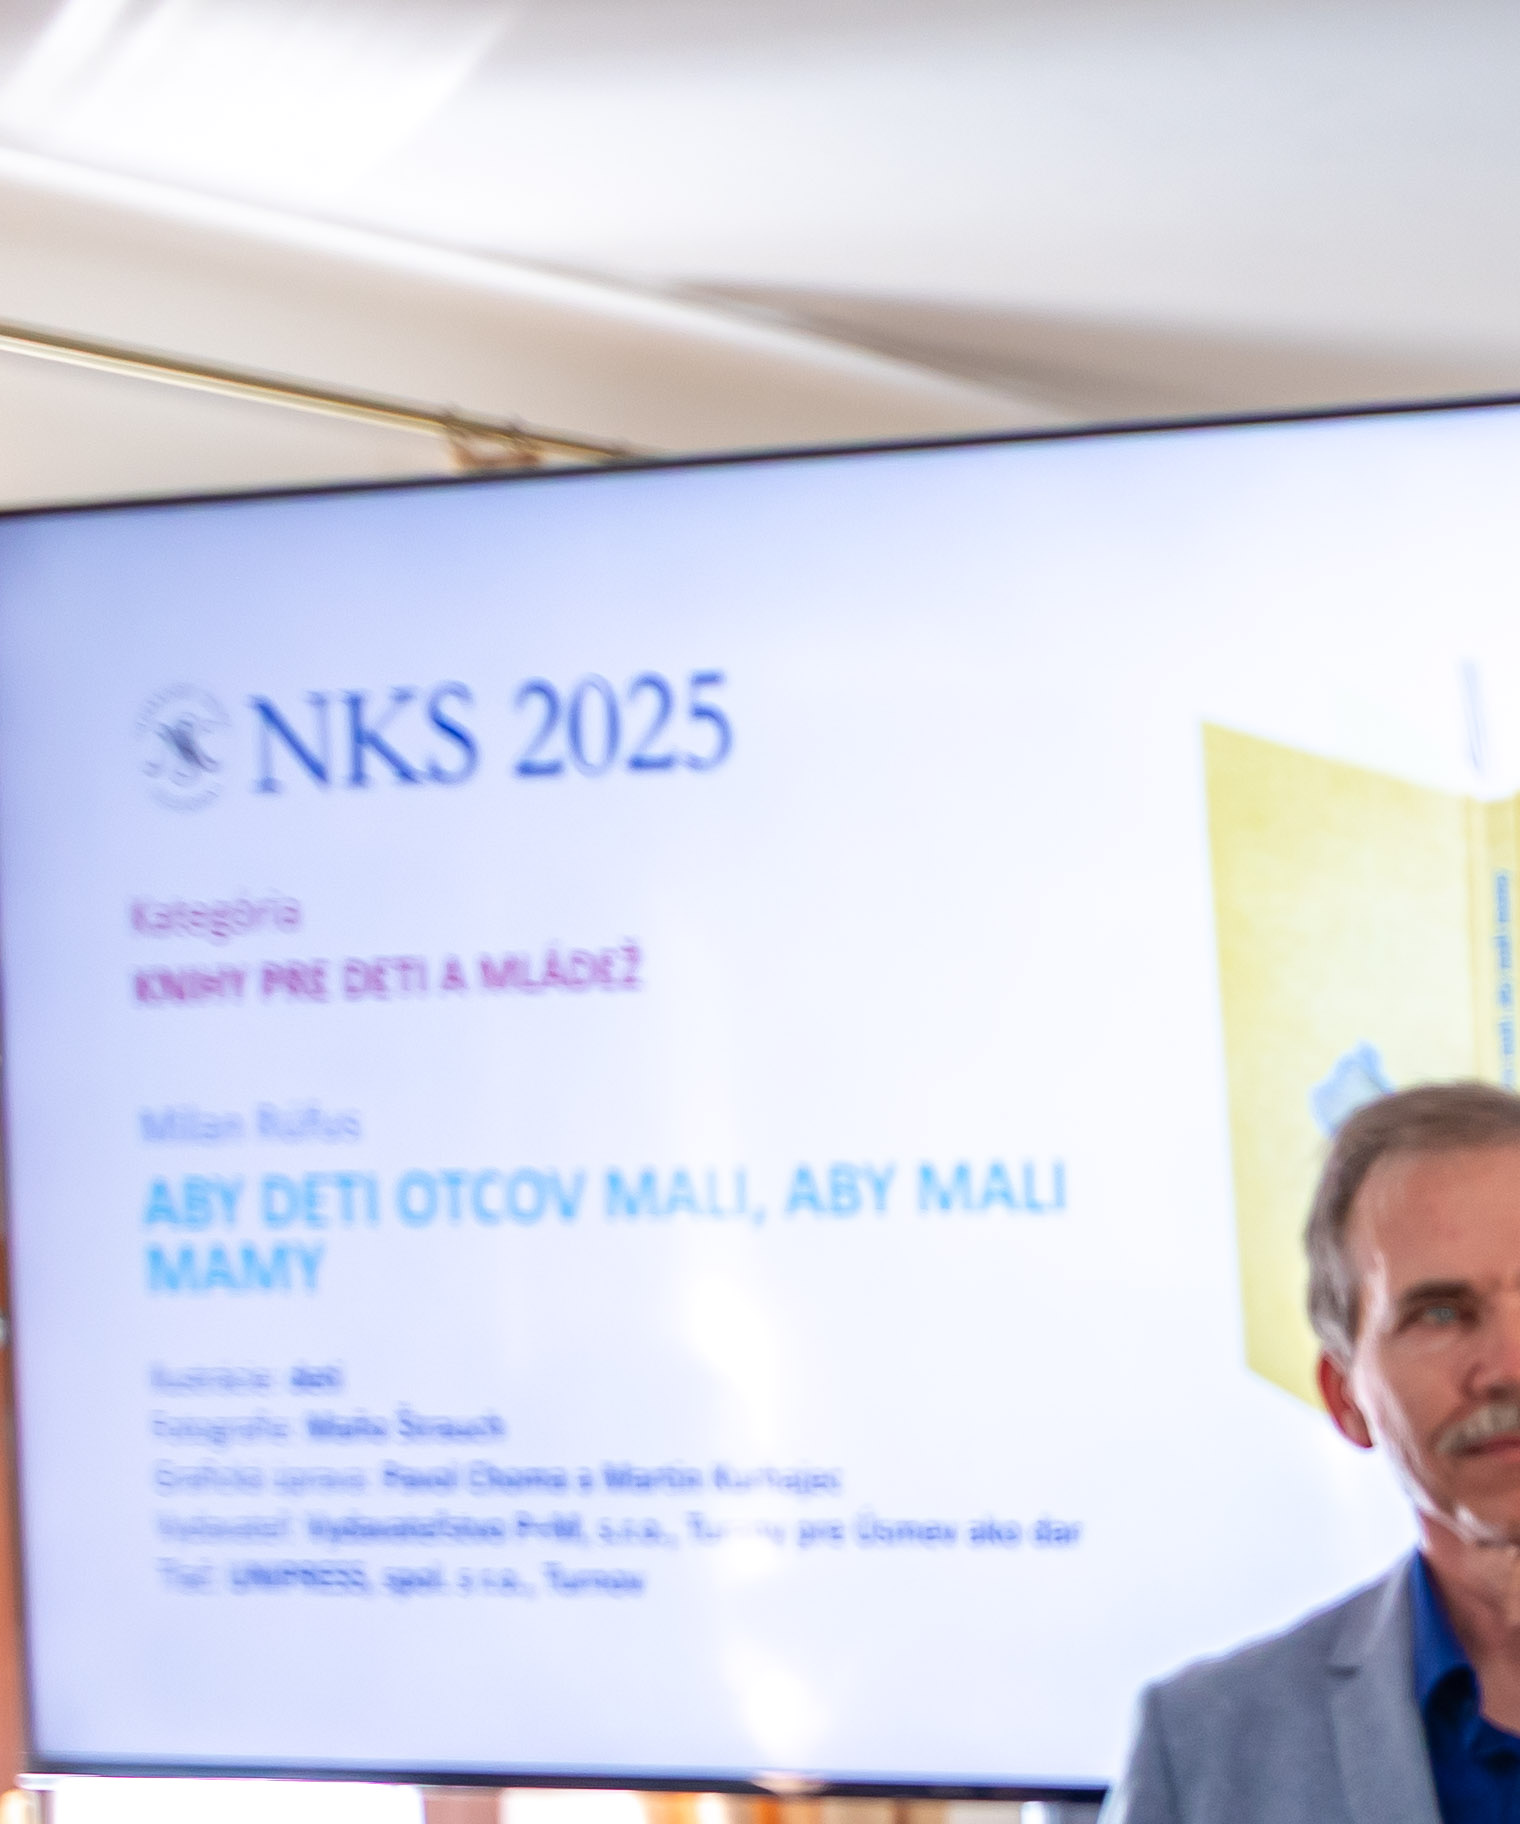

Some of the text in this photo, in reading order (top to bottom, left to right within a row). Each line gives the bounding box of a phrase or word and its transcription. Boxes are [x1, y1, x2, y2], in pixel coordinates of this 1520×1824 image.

[249, 681, 479, 794] NKS
[513, 668, 734, 777] 2025
[133, 937, 644, 1003] KNIHY PRE DETI A MLÁDEŽ
[144, 1156, 1067, 1230] ABY DETI OTCOV MALI, ABY MALI
[146, 1240, 324, 1294] MAMY
